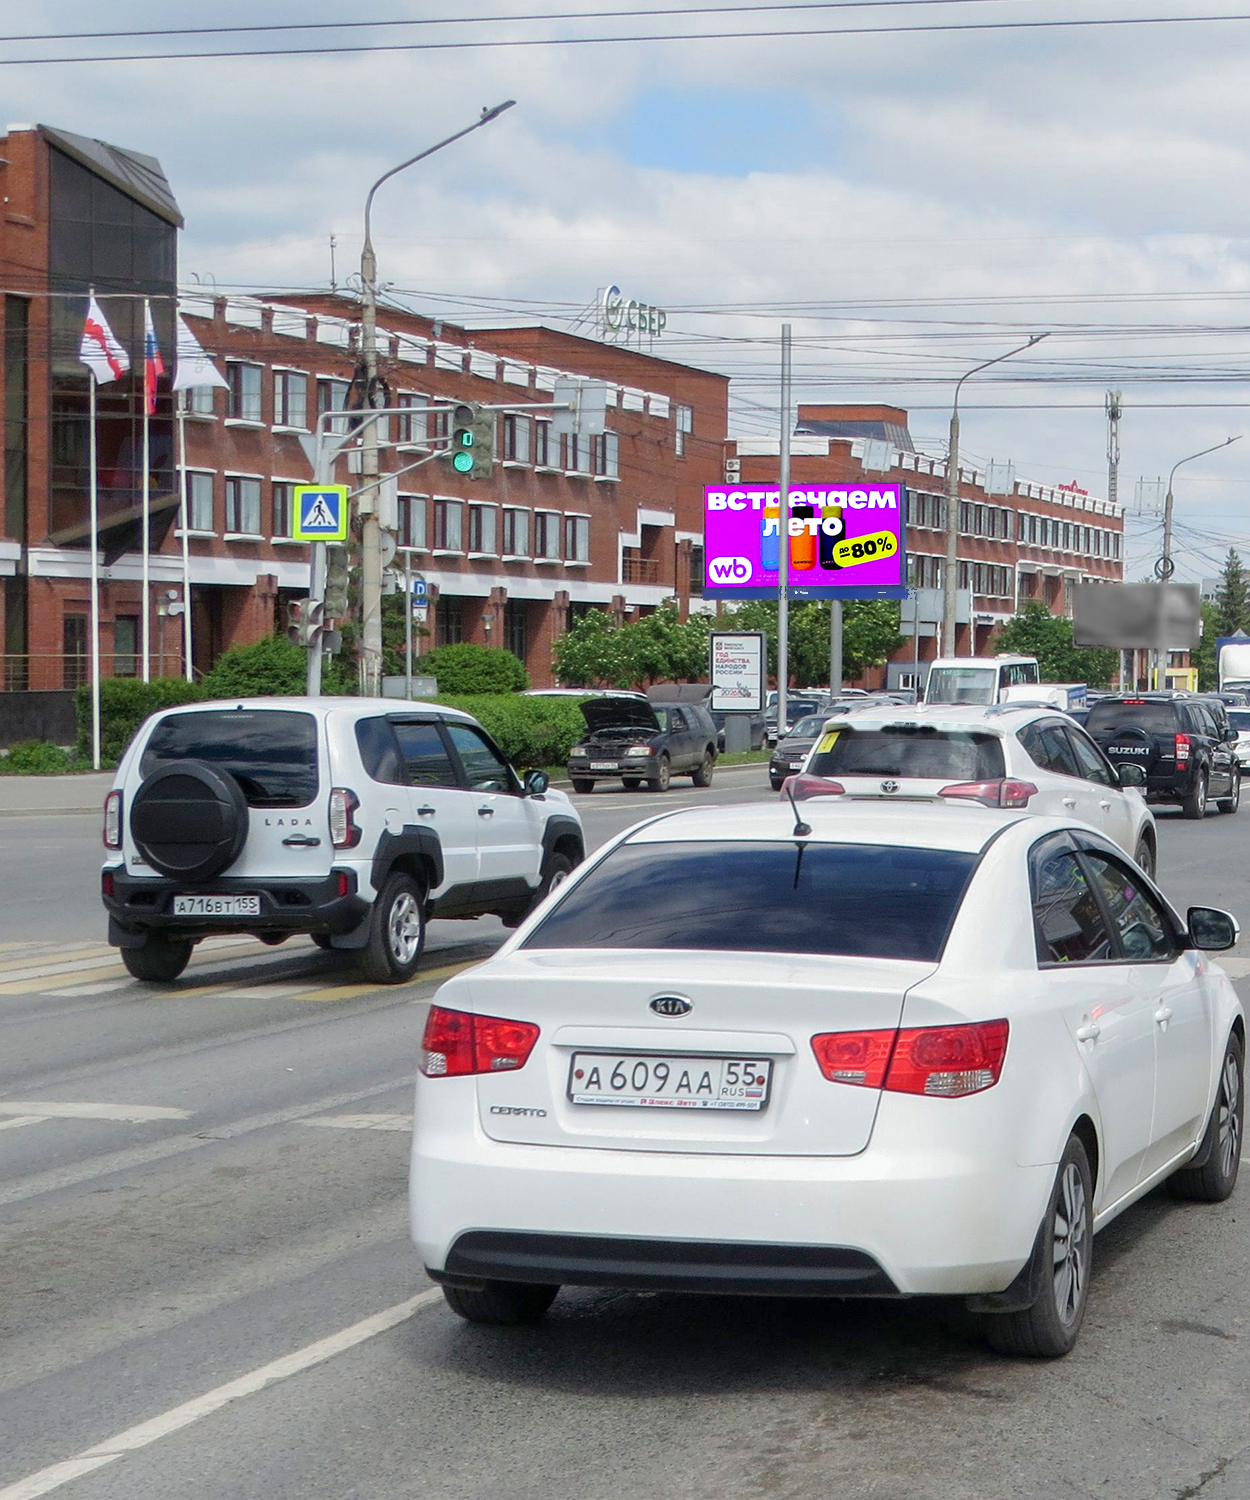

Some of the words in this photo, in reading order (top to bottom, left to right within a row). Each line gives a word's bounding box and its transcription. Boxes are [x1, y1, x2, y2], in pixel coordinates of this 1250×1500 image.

[625, 300, 667, 337] СБЕР
[707, 490, 897, 511] встречаем
[763, 517, 843, 537] лето
[713, 559, 747, 578] wb
[1108, 746, 1150, 755] SUZUKI
[264, 818, 313, 826] LADA
[178, 898, 232, 913] А716ВТ
[235, 897, 256, 909] 155
[656, 1000, 685, 1013] KIA
[585, 1060, 713, 1094] А609АА
[725, 1062, 757, 1086] 55
[721, 1087, 745, 1097] RUS
